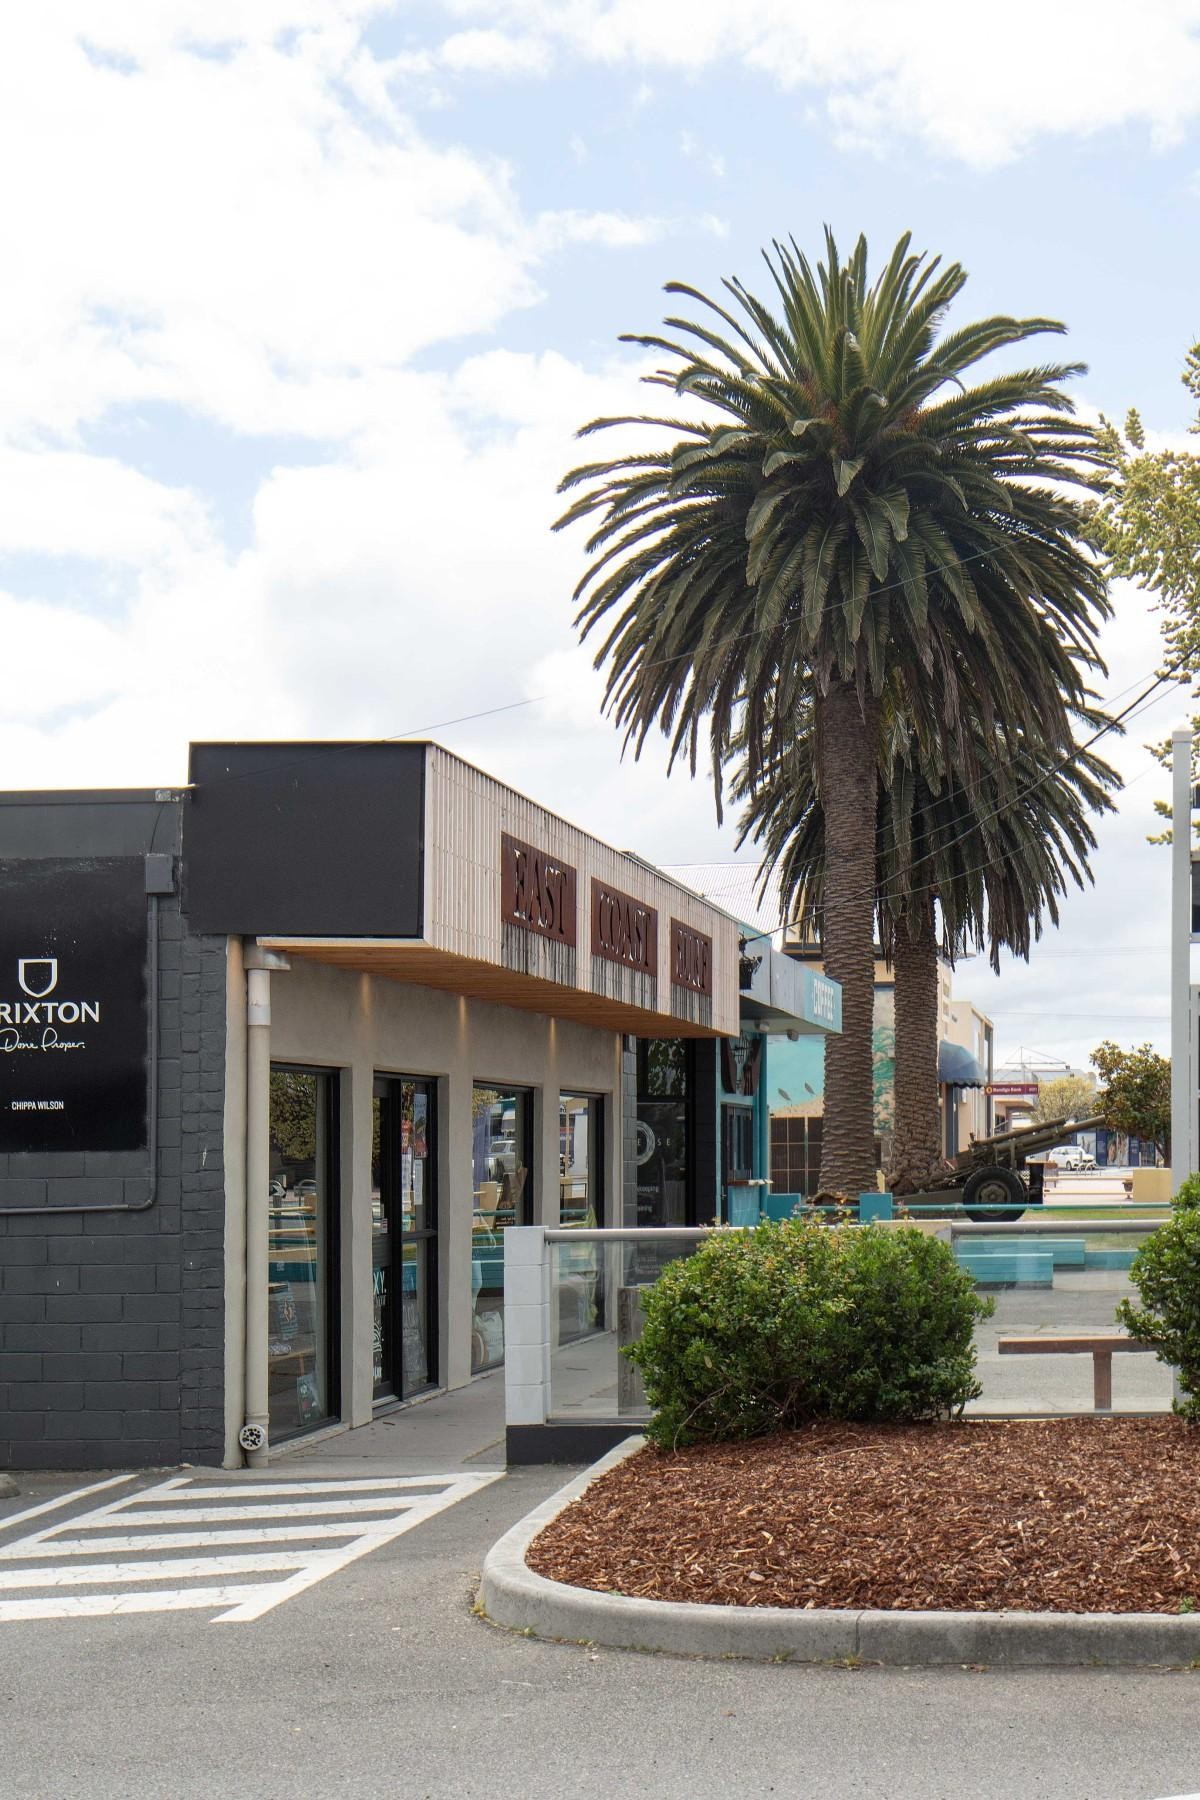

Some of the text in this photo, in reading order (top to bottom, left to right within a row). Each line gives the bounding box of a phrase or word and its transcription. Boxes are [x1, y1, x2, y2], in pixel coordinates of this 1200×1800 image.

[513, 847, 709, 989] EAST COAST SURF
[11, 1101, 64, 1110] CHIPPA WILSON
